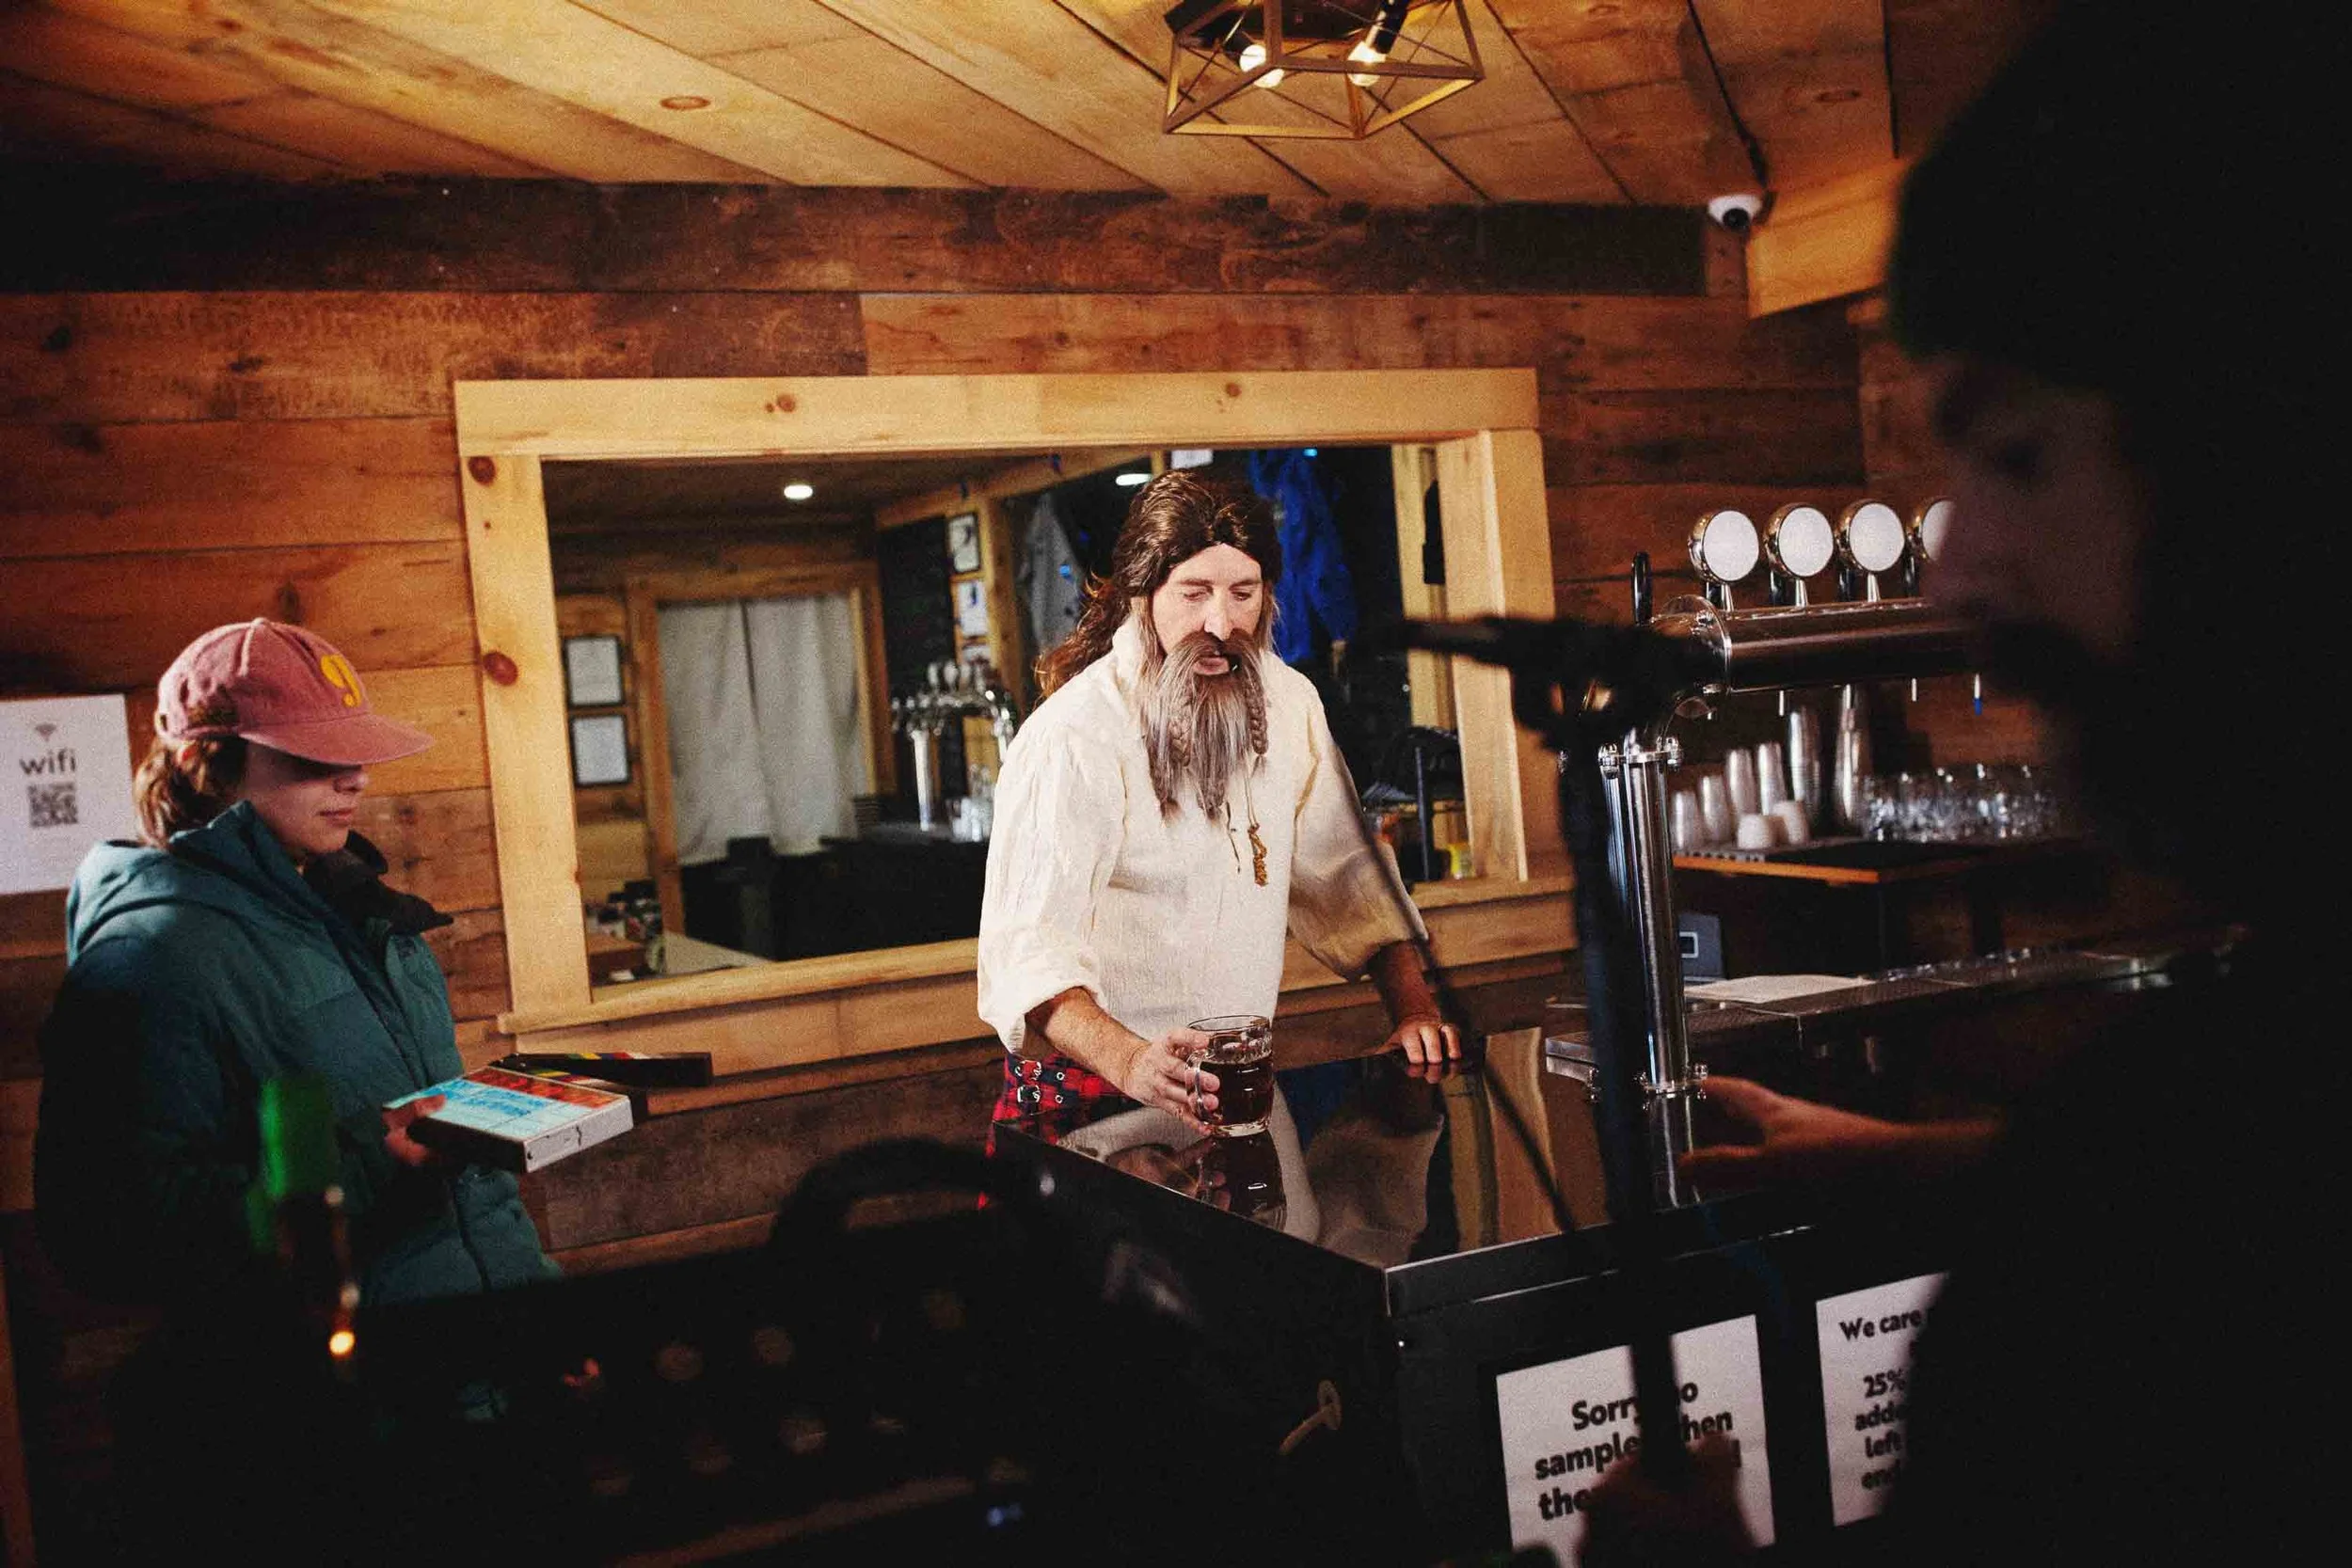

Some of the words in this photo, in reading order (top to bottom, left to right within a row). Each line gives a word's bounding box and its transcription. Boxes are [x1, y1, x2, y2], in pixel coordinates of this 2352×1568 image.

[19, 748, 76, 775] wifi
[1839, 1318, 1875, 1341] We
[1880, 1309, 1921, 1334] care
[1864, 1368, 1905, 1398] 25%
[1534, 1431, 1642, 1481] sample
[1680, 1411, 1733, 1443] hen
